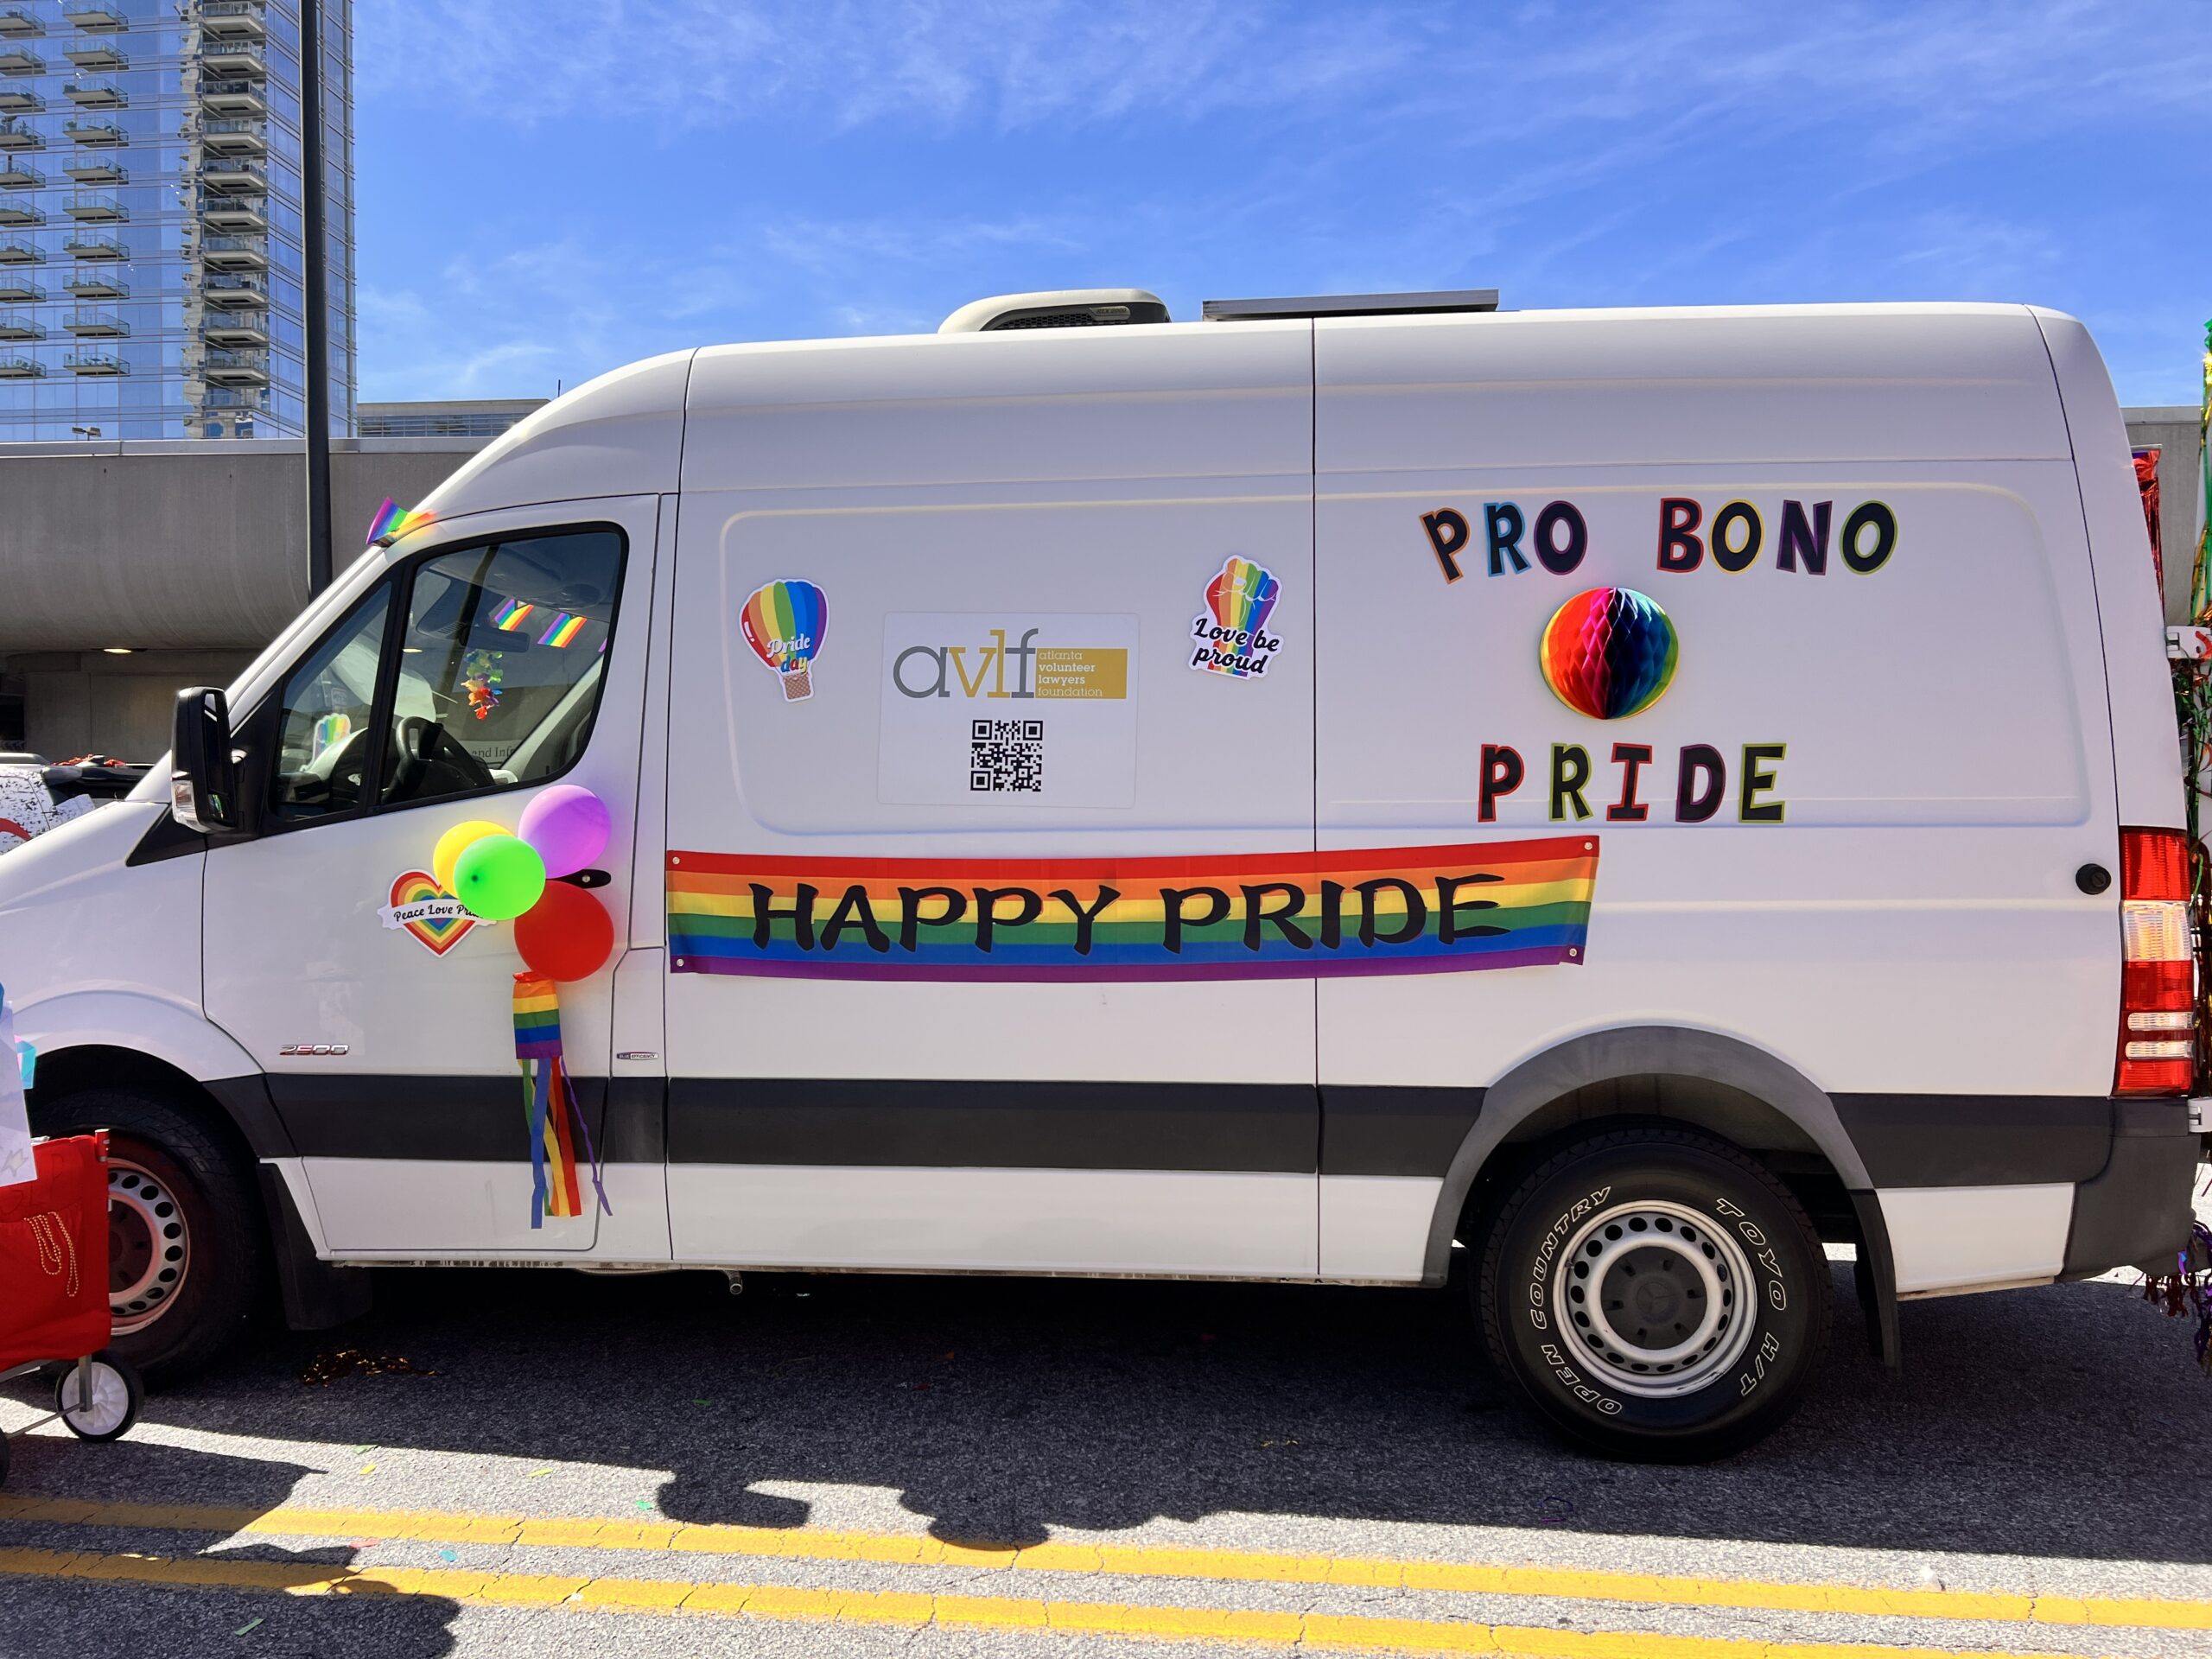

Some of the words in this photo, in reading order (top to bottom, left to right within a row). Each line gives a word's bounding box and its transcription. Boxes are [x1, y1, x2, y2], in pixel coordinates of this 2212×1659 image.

[1420, 500, 1588, 585] PRO
[1656, 498, 1898, 575] BONO
[766, 633, 810, 658] Pride
[1194, 618, 1248, 645] Love
[1253, 629, 1280, 652] be
[781, 656, 808, 674] day
[893, 628, 1039, 698] avlf
[1039, 650, 1083, 660] atlanta
[1039, 663, 1096, 672] volunteer
[1192, 647, 1268, 673] proud
[1038, 674, 1086, 686] lawyers
[1038, 686, 1103, 696] foundation
[1478, 742, 1787, 823] PRIDE
[393, 907, 424, 922] Peace
[428, 904, 453, 915] Love
[456, 904, 484, 918] Pri
[748, 882, 1122, 956] HAPPY
[1159, 873, 1512, 954] PRIDE
[279, 1044, 349, 1055] 2500
[1529, 1185, 1611, 1329] COUNTRY
[1716, 1198, 1787, 1311] TOYO
[1740, 1332, 1780, 1396] H/T
[1541, 1344, 1623, 1415] OPEN
